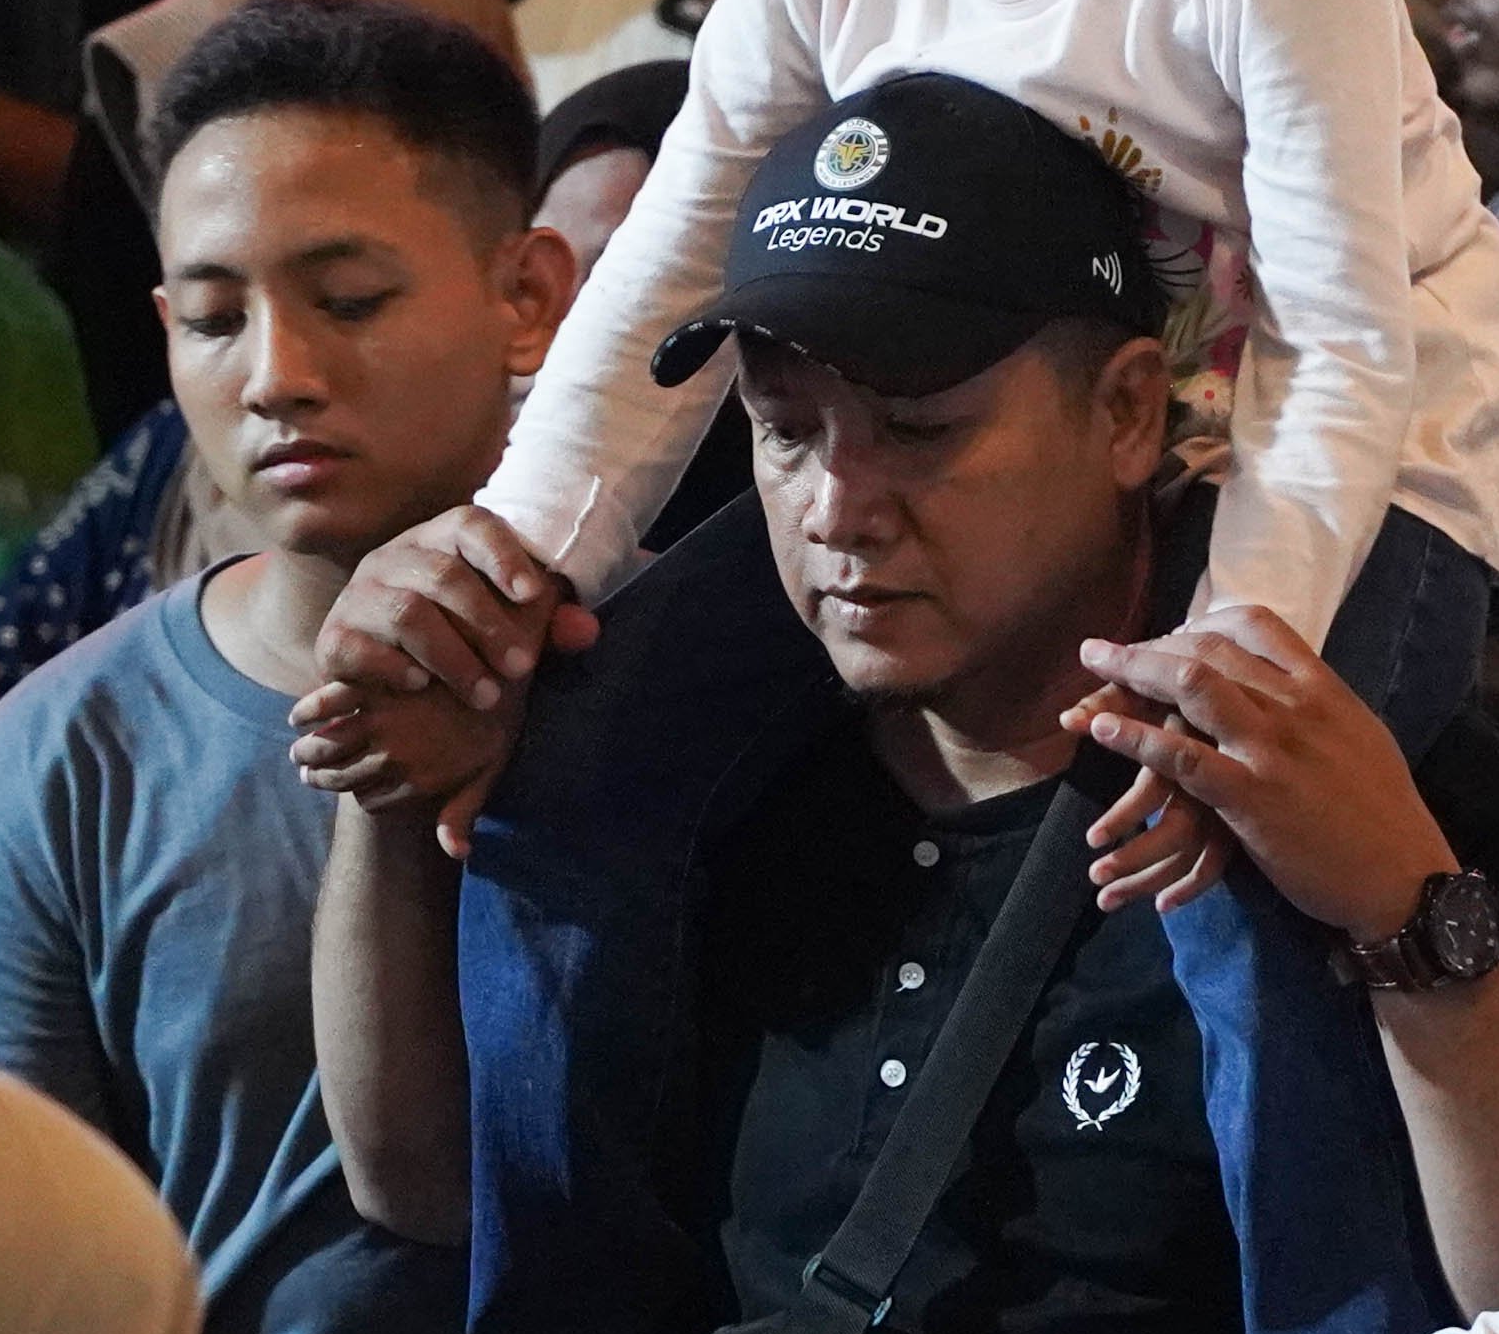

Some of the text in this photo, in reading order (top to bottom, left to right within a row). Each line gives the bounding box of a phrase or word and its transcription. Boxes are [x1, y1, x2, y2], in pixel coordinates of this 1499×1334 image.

[752, 196, 949, 240] DRX WORLD
[766, 225, 886, 253] Legends
